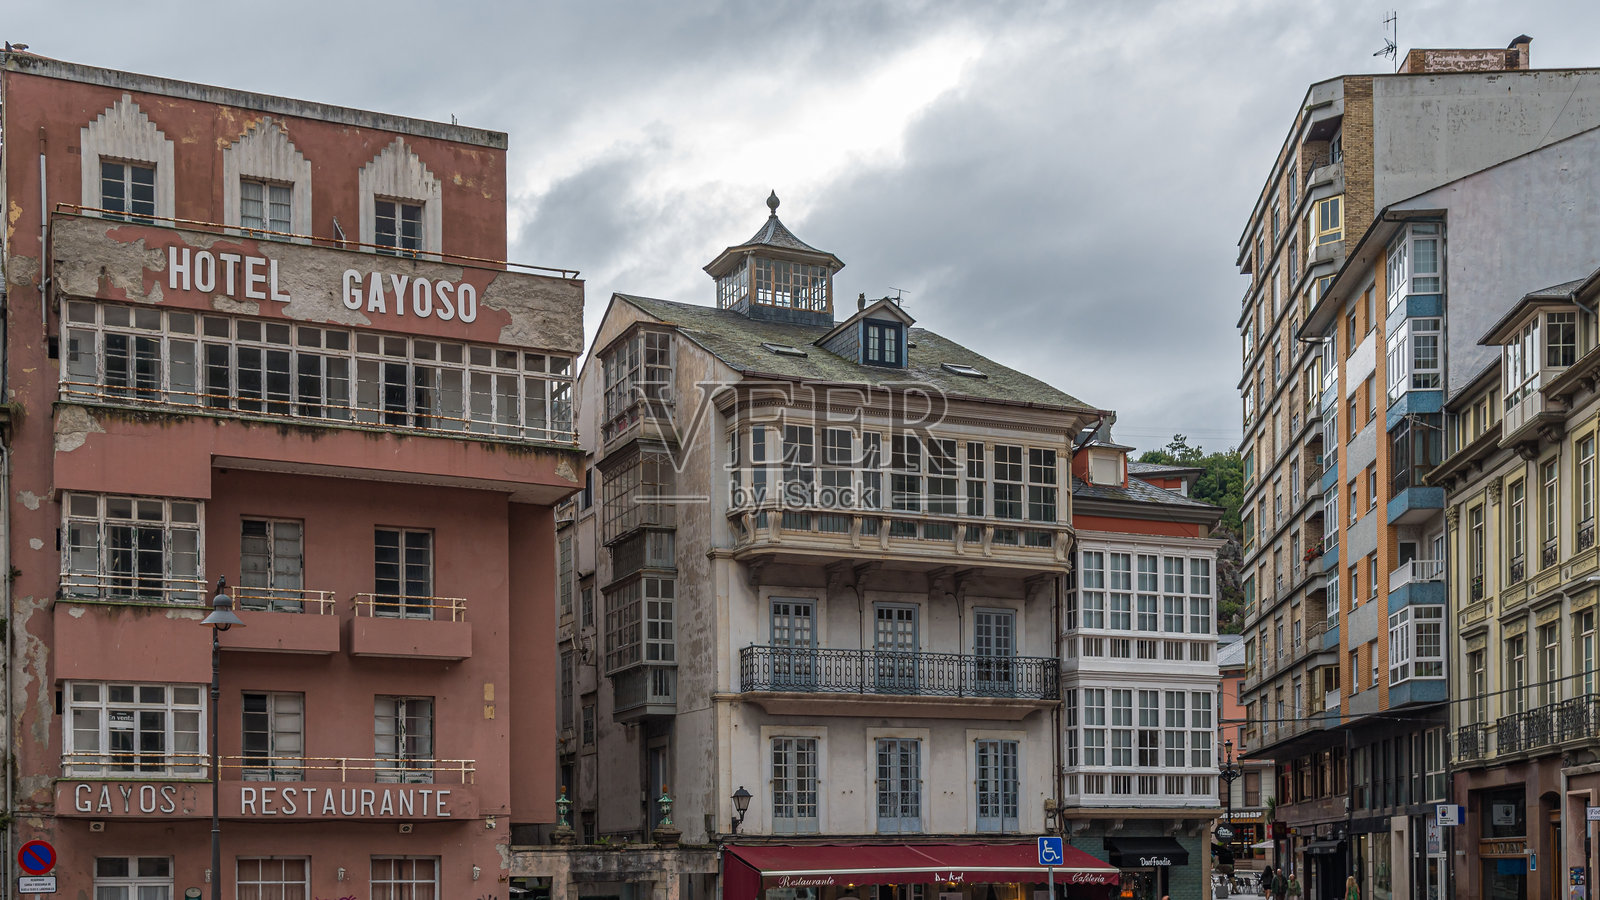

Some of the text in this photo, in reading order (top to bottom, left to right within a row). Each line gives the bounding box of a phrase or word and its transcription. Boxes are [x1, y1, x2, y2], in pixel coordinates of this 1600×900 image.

[169, 246, 477, 323] HOTEL GAYOSO
[241, 787, 451, 817] RESTAURANTE
[779, 875, 835, 888] Restaurante
